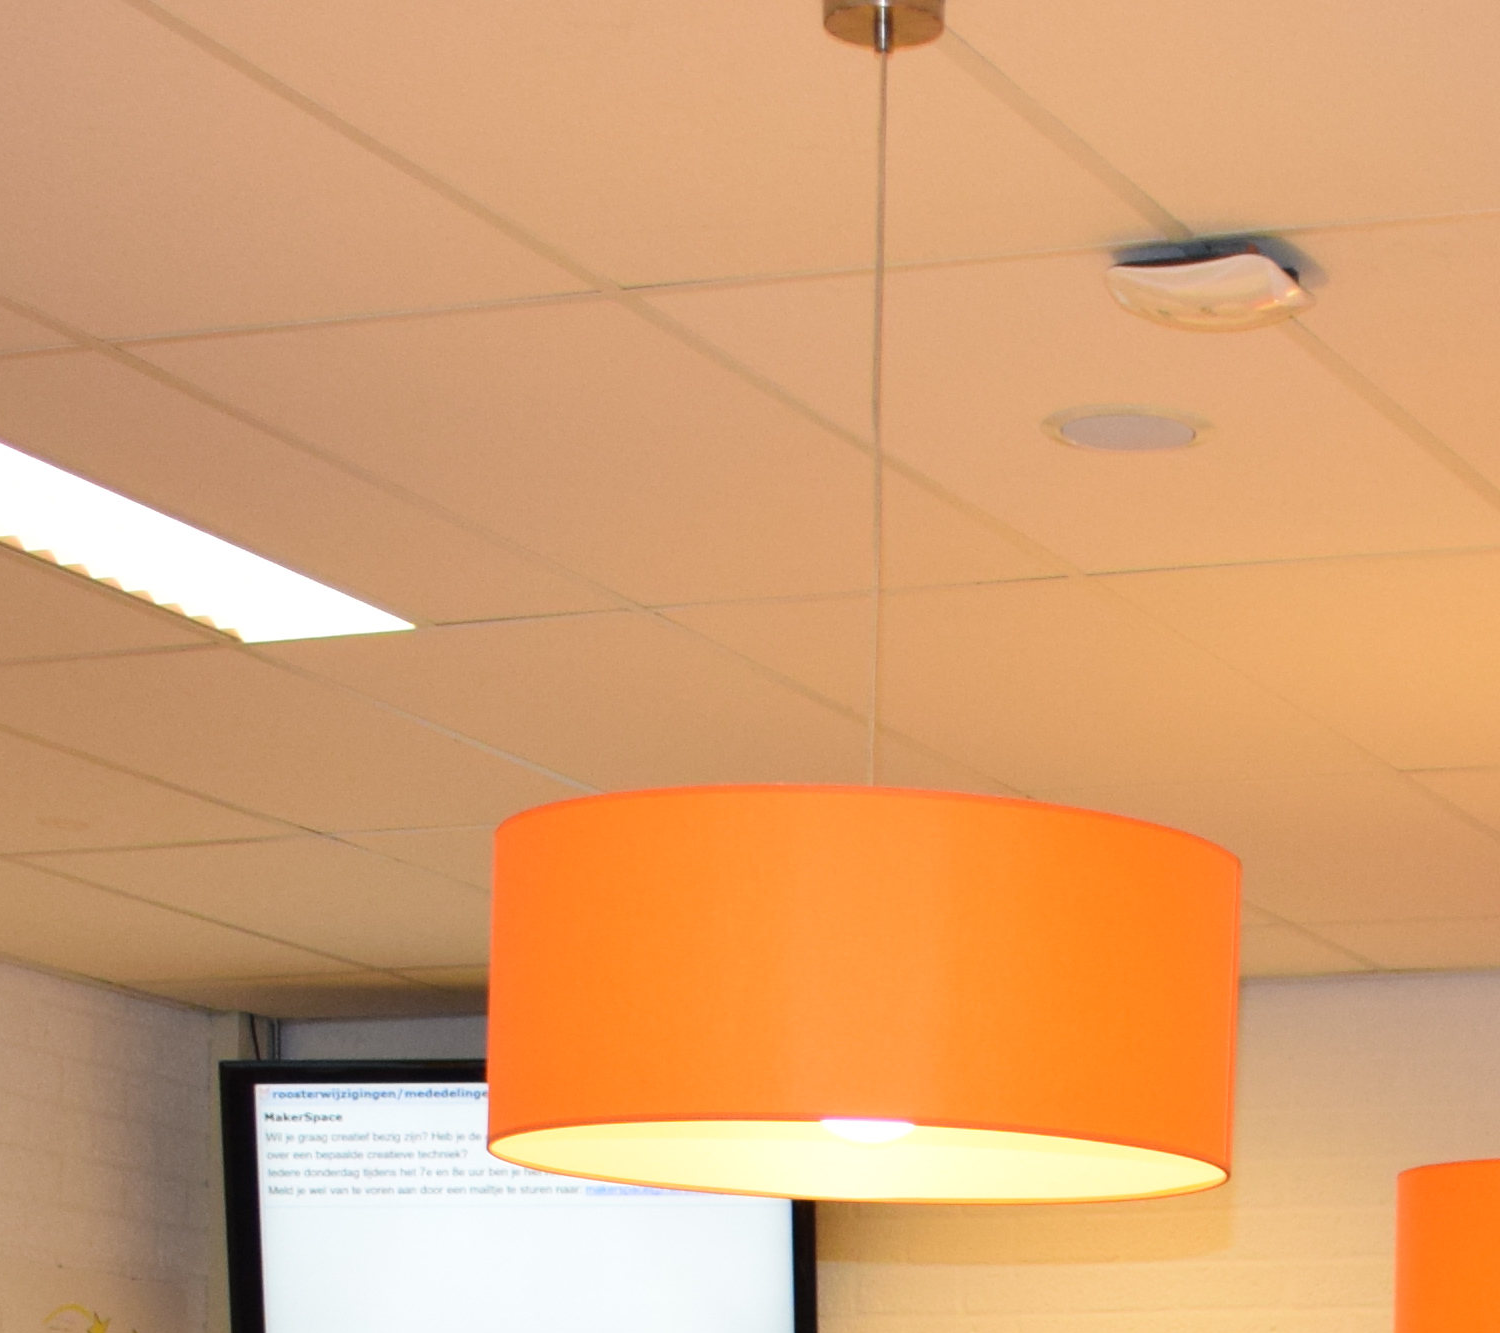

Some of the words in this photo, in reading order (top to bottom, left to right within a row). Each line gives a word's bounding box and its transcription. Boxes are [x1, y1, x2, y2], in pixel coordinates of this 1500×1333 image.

[272, 1088, 488, 1101] roosterwijzigingen/mededelinge
[264, 1112, 343, 1123] MakerSpace
[298, 1133, 328, 1144] graag
[331, 1132, 370, 1142] creatief
[372, 1132, 401, 1144] bezig
[267, 1151, 289, 1160] over
[293, 1151, 313, 1160] een
[315, 1149, 364, 1161] bepaalde
[367, 1149, 415, 1160] creatieve
[418, 1148, 468, 1160] techniek?
[304, 1167, 360, 1179] donderdag
[362, 1167, 397, 1179] tijdens
[330, 1186, 349, 1195] van
[365, 1186, 395, 1195] voren
[420, 1184, 443, 1195] door
[447, 1186, 467, 1195] een
[520, 1185, 553, 1195] sturen
